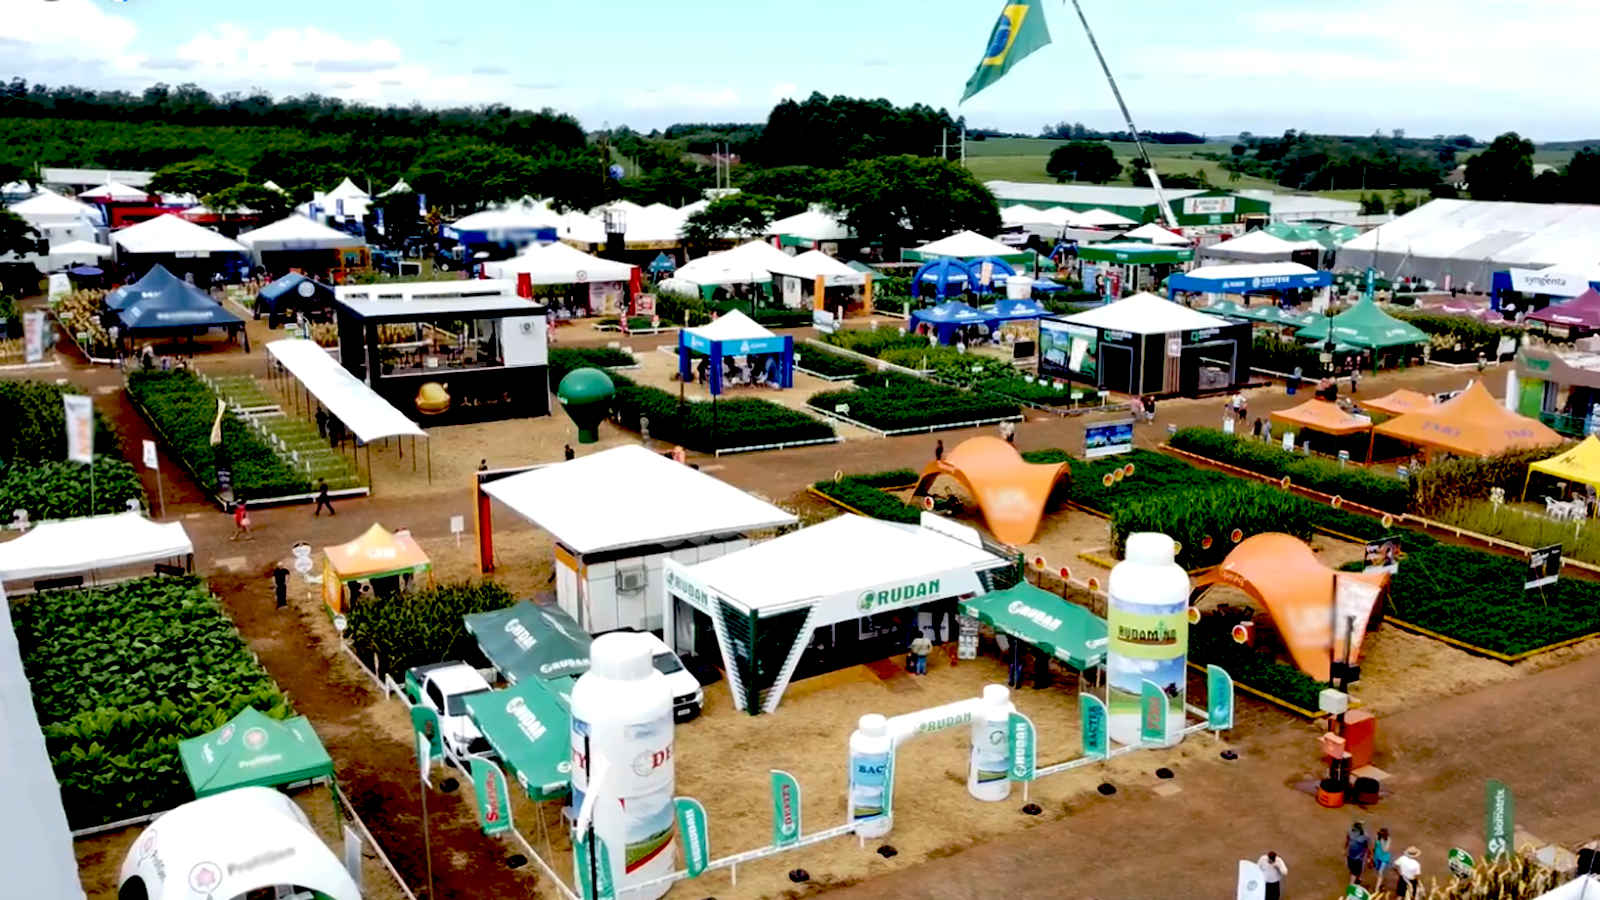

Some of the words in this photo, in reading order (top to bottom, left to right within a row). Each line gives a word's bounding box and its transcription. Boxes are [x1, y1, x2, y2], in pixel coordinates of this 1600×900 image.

[1524, 274, 1566, 287] syngenta
[674, 575, 709, 606] RUDAN
[877, 578, 941, 606] RUDAN
[1020, 606, 1063, 631] RUDAN
[927, 712, 972, 732] RUDAN
[1014, 722, 1027, 764] RUDAN
[1493, 788, 1506, 837] biomatrix
